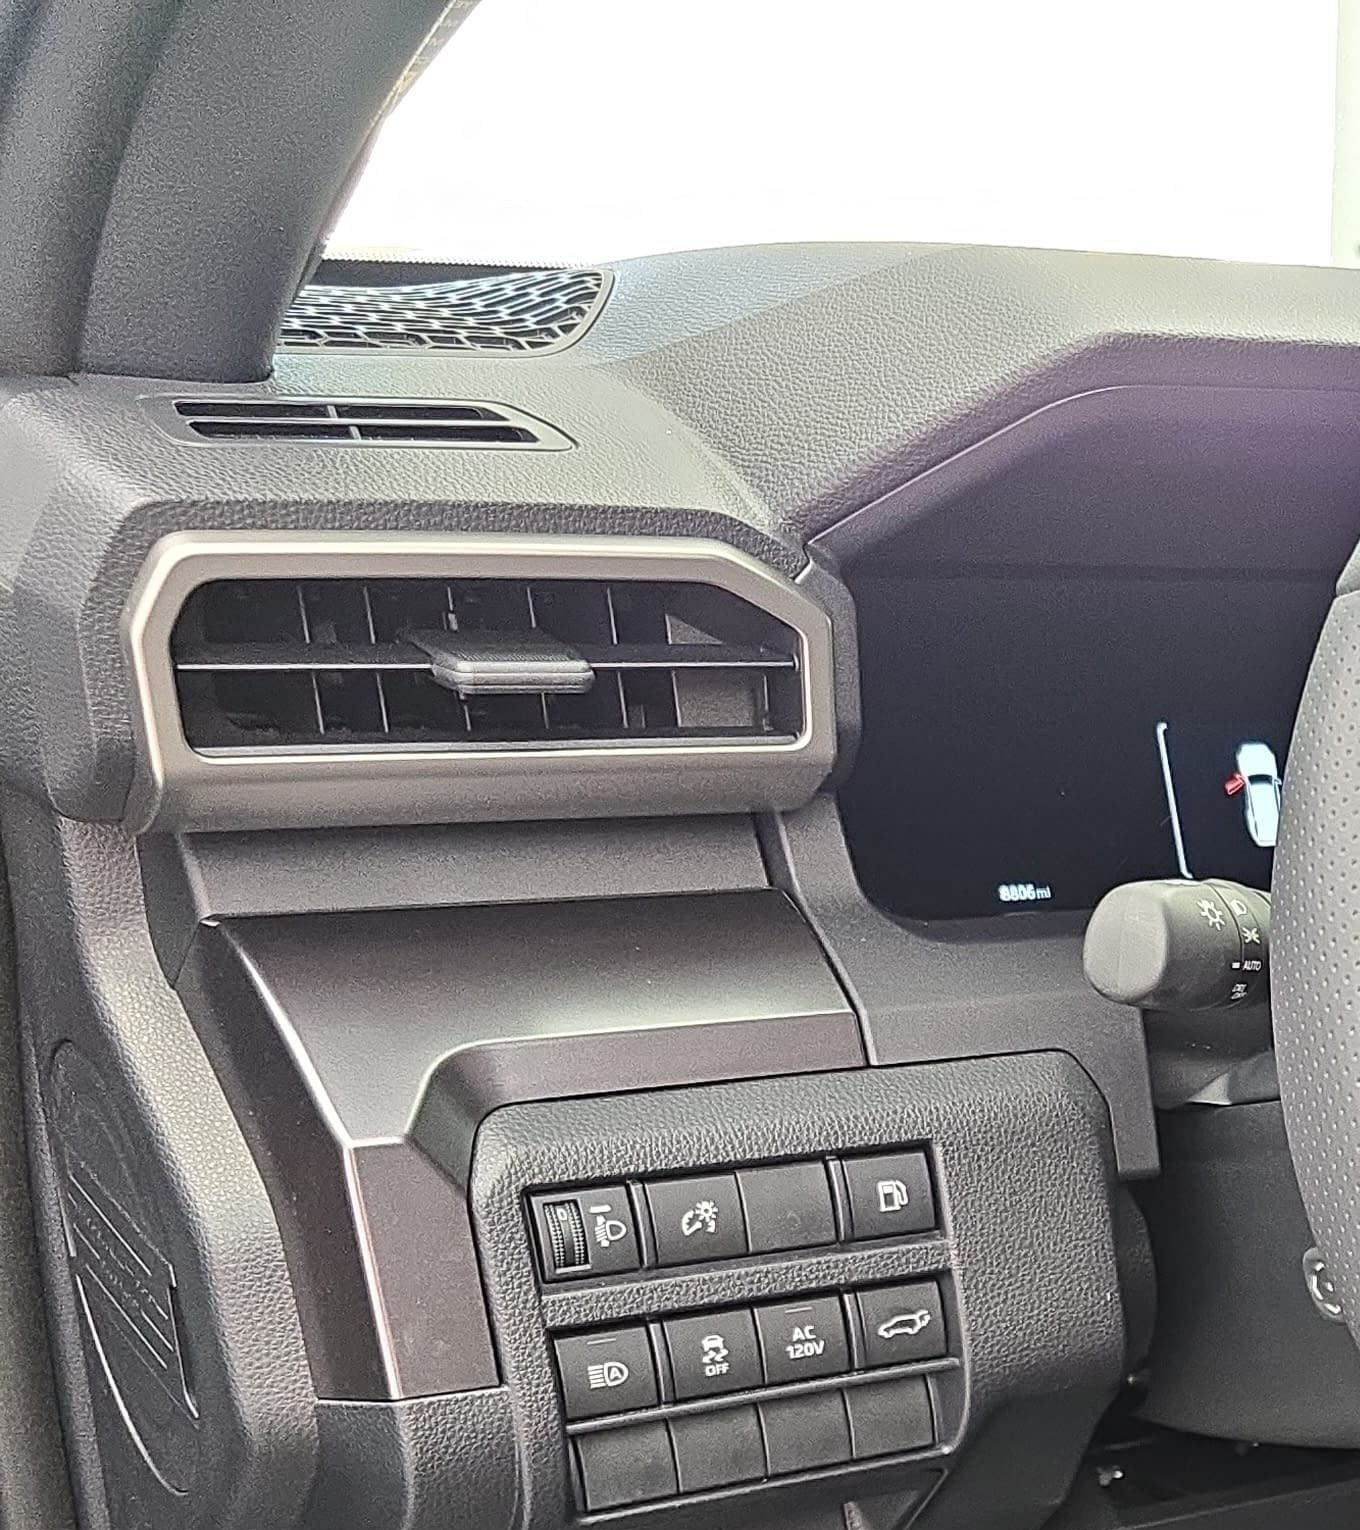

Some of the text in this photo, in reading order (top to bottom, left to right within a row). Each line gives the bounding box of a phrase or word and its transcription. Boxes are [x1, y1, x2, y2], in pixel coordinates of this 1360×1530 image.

[1242, 961, 1262, 972] AUTO
[792, 1325, 817, 1341] AC
[786, 1339, 825, 1360] 120V
[704, 1362, 730, 1378] OFF
